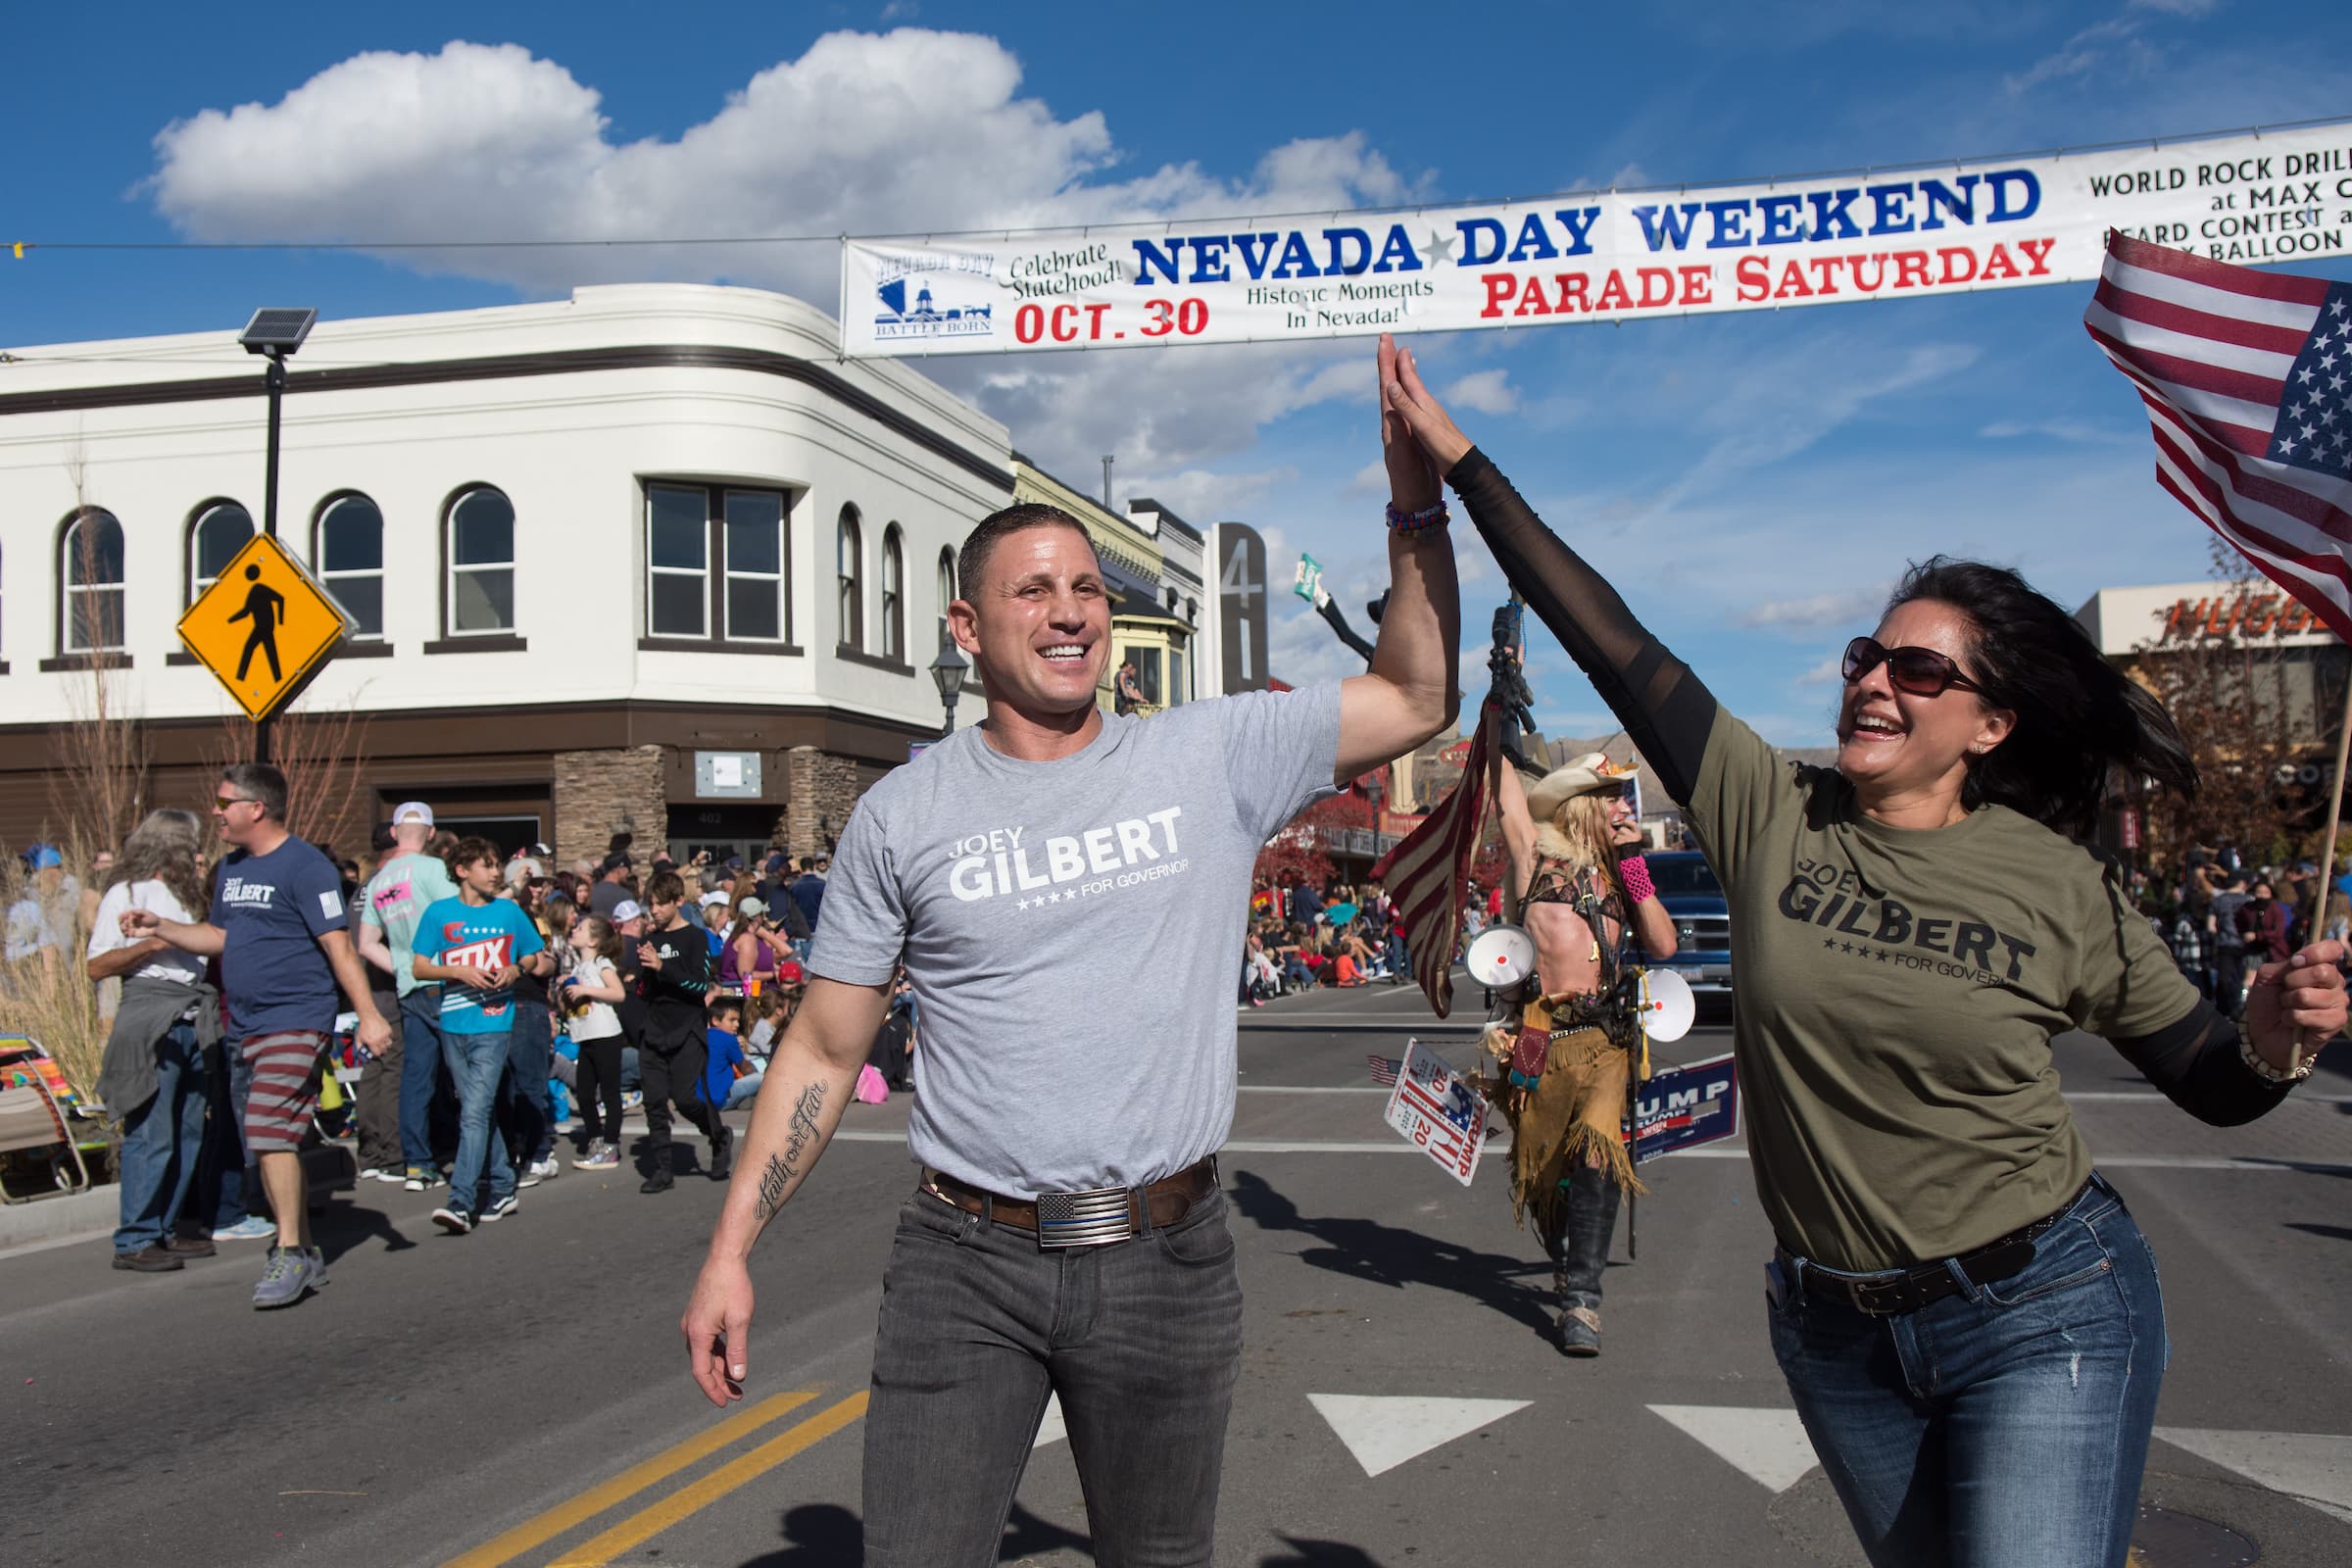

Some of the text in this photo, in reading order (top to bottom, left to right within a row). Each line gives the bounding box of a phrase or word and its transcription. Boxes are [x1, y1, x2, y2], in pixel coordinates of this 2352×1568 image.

[2089, 147, 2352, 197] WORLD ROCK DRIL
[2211, 192, 2236, 211] at
[2249, 181, 2323, 208] MAX
[1132, 169, 2041, 285] NEVADA DAY WEEKEND
[2103, 221, 2189, 249] ARD
[2201, 207, 2325, 238] CONTEST
[2210, 229, 2342, 260] BALLOON
[1010, 243, 1108, 279] Celebrate
[1481, 238, 2055, 318] PARADE SATURDAY
[1012, 259, 1123, 301] Statehood!
[1248, 279, 1435, 307] Historic Moments
[948, 320, 992, 333] BORN
[1015, 297, 1210, 344] OCT. 30
[1287, 308, 1399, 328] In Nevada!
[699, 812, 721, 824] 402
[948, 826, 1023, 859] JOEY
[949, 806, 1182, 903] GILBERT
[222, 884, 275, 902] GILBERT
[1081, 858, 1190, 897] FOR GOVERNOR
[1797, 858, 1864, 896] JOE
[1778, 874, 2036, 981] GILBERT
[445, 938, 506, 973] FOX
[1894, 954, 1933, 972] FOR
[1457, 1102, 1484, 1177] TRUMP
[1642, 1121, 1667, 1136] WON
[754, 1079, 829, 1220] Faith over Fear
